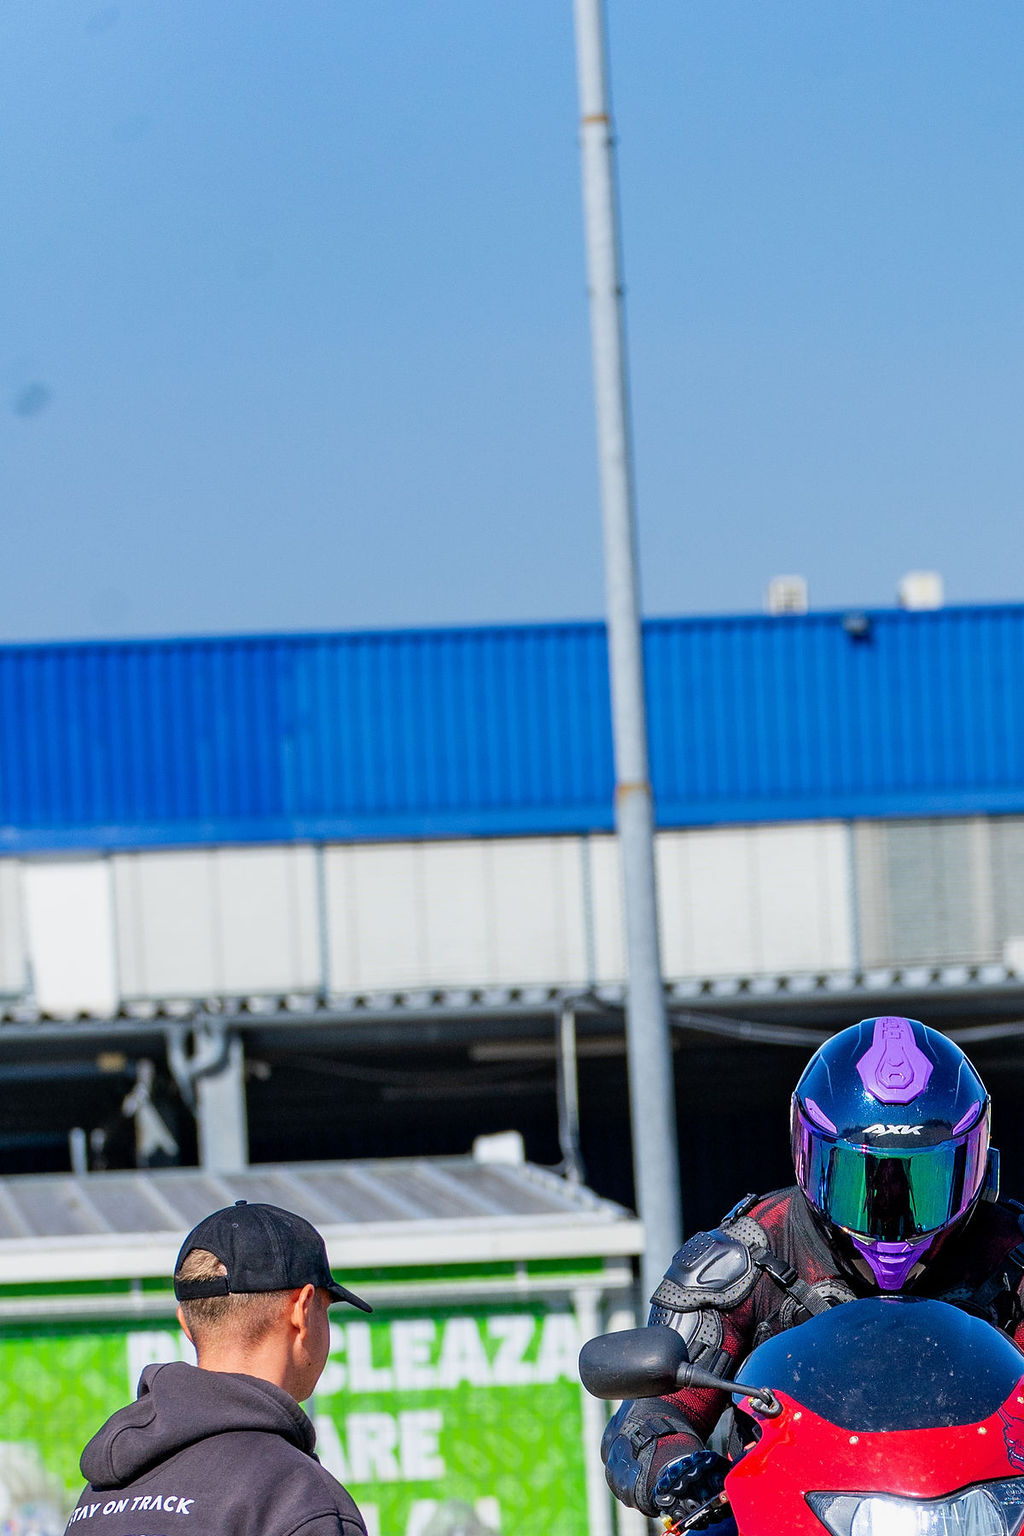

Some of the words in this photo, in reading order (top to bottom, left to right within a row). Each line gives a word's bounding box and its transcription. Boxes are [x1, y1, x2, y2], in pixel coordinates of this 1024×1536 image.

[862, 1123, 924, 1138] AXK
[102, 1498, 130, 1515] ON
[131, 1495, 195, 1515] TRACK
